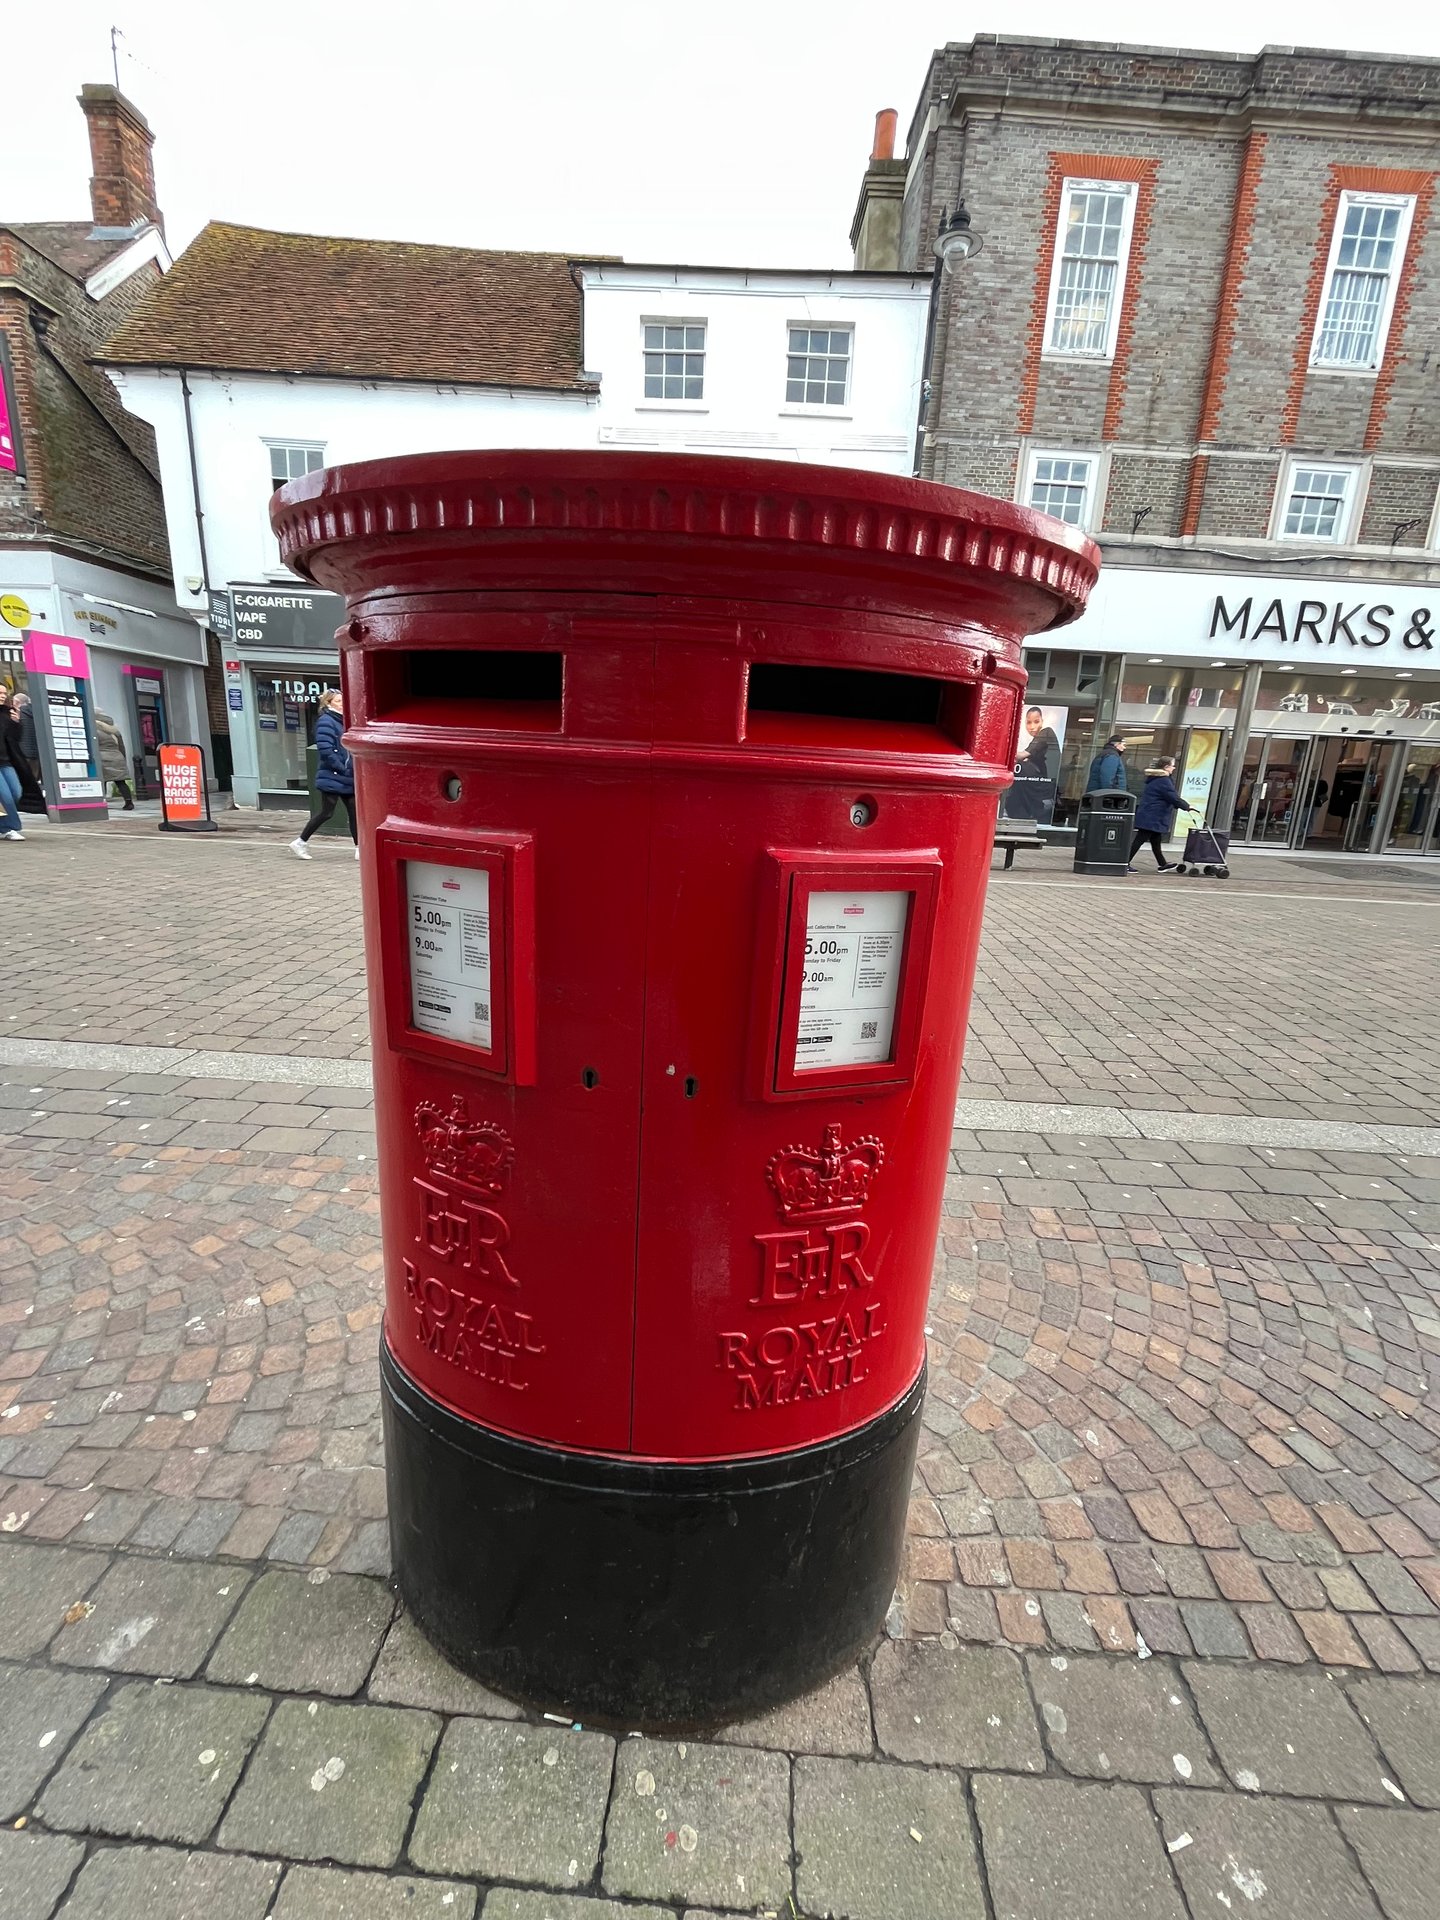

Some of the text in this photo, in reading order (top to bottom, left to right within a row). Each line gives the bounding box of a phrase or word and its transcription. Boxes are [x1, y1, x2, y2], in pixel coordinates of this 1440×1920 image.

[234, 594, 313, 610] E-CIGARETTE
[210, 613, 232, 627] TIDAL
[236, 611, 267, 624] VAPE
[1209, 595, 1436, 651] MARKS &
[237, 628, 263, 640] CBD
[290, 695, 316, 703] VAPE
[163, 764, 198, 776] HUGE
[163, 776, 198, 787] VAPE
[1186, 776, 1208, 786] M&S
[164, 788, 198, 797] RANGE
[165, 797, 198, 805] IN STORE
[853, 809, 864, 825] 6
[414, 906, 452, 927] 5.00pm
[415, 937, 443, 952] 9.00am
[402, 1256, 548, 1355] ROYAL
[715, 1302, 888, 1370] ROYAL
[414, 1306, 530, 1391] MAIL
[734, 1349, 870, 1410] MAIL
